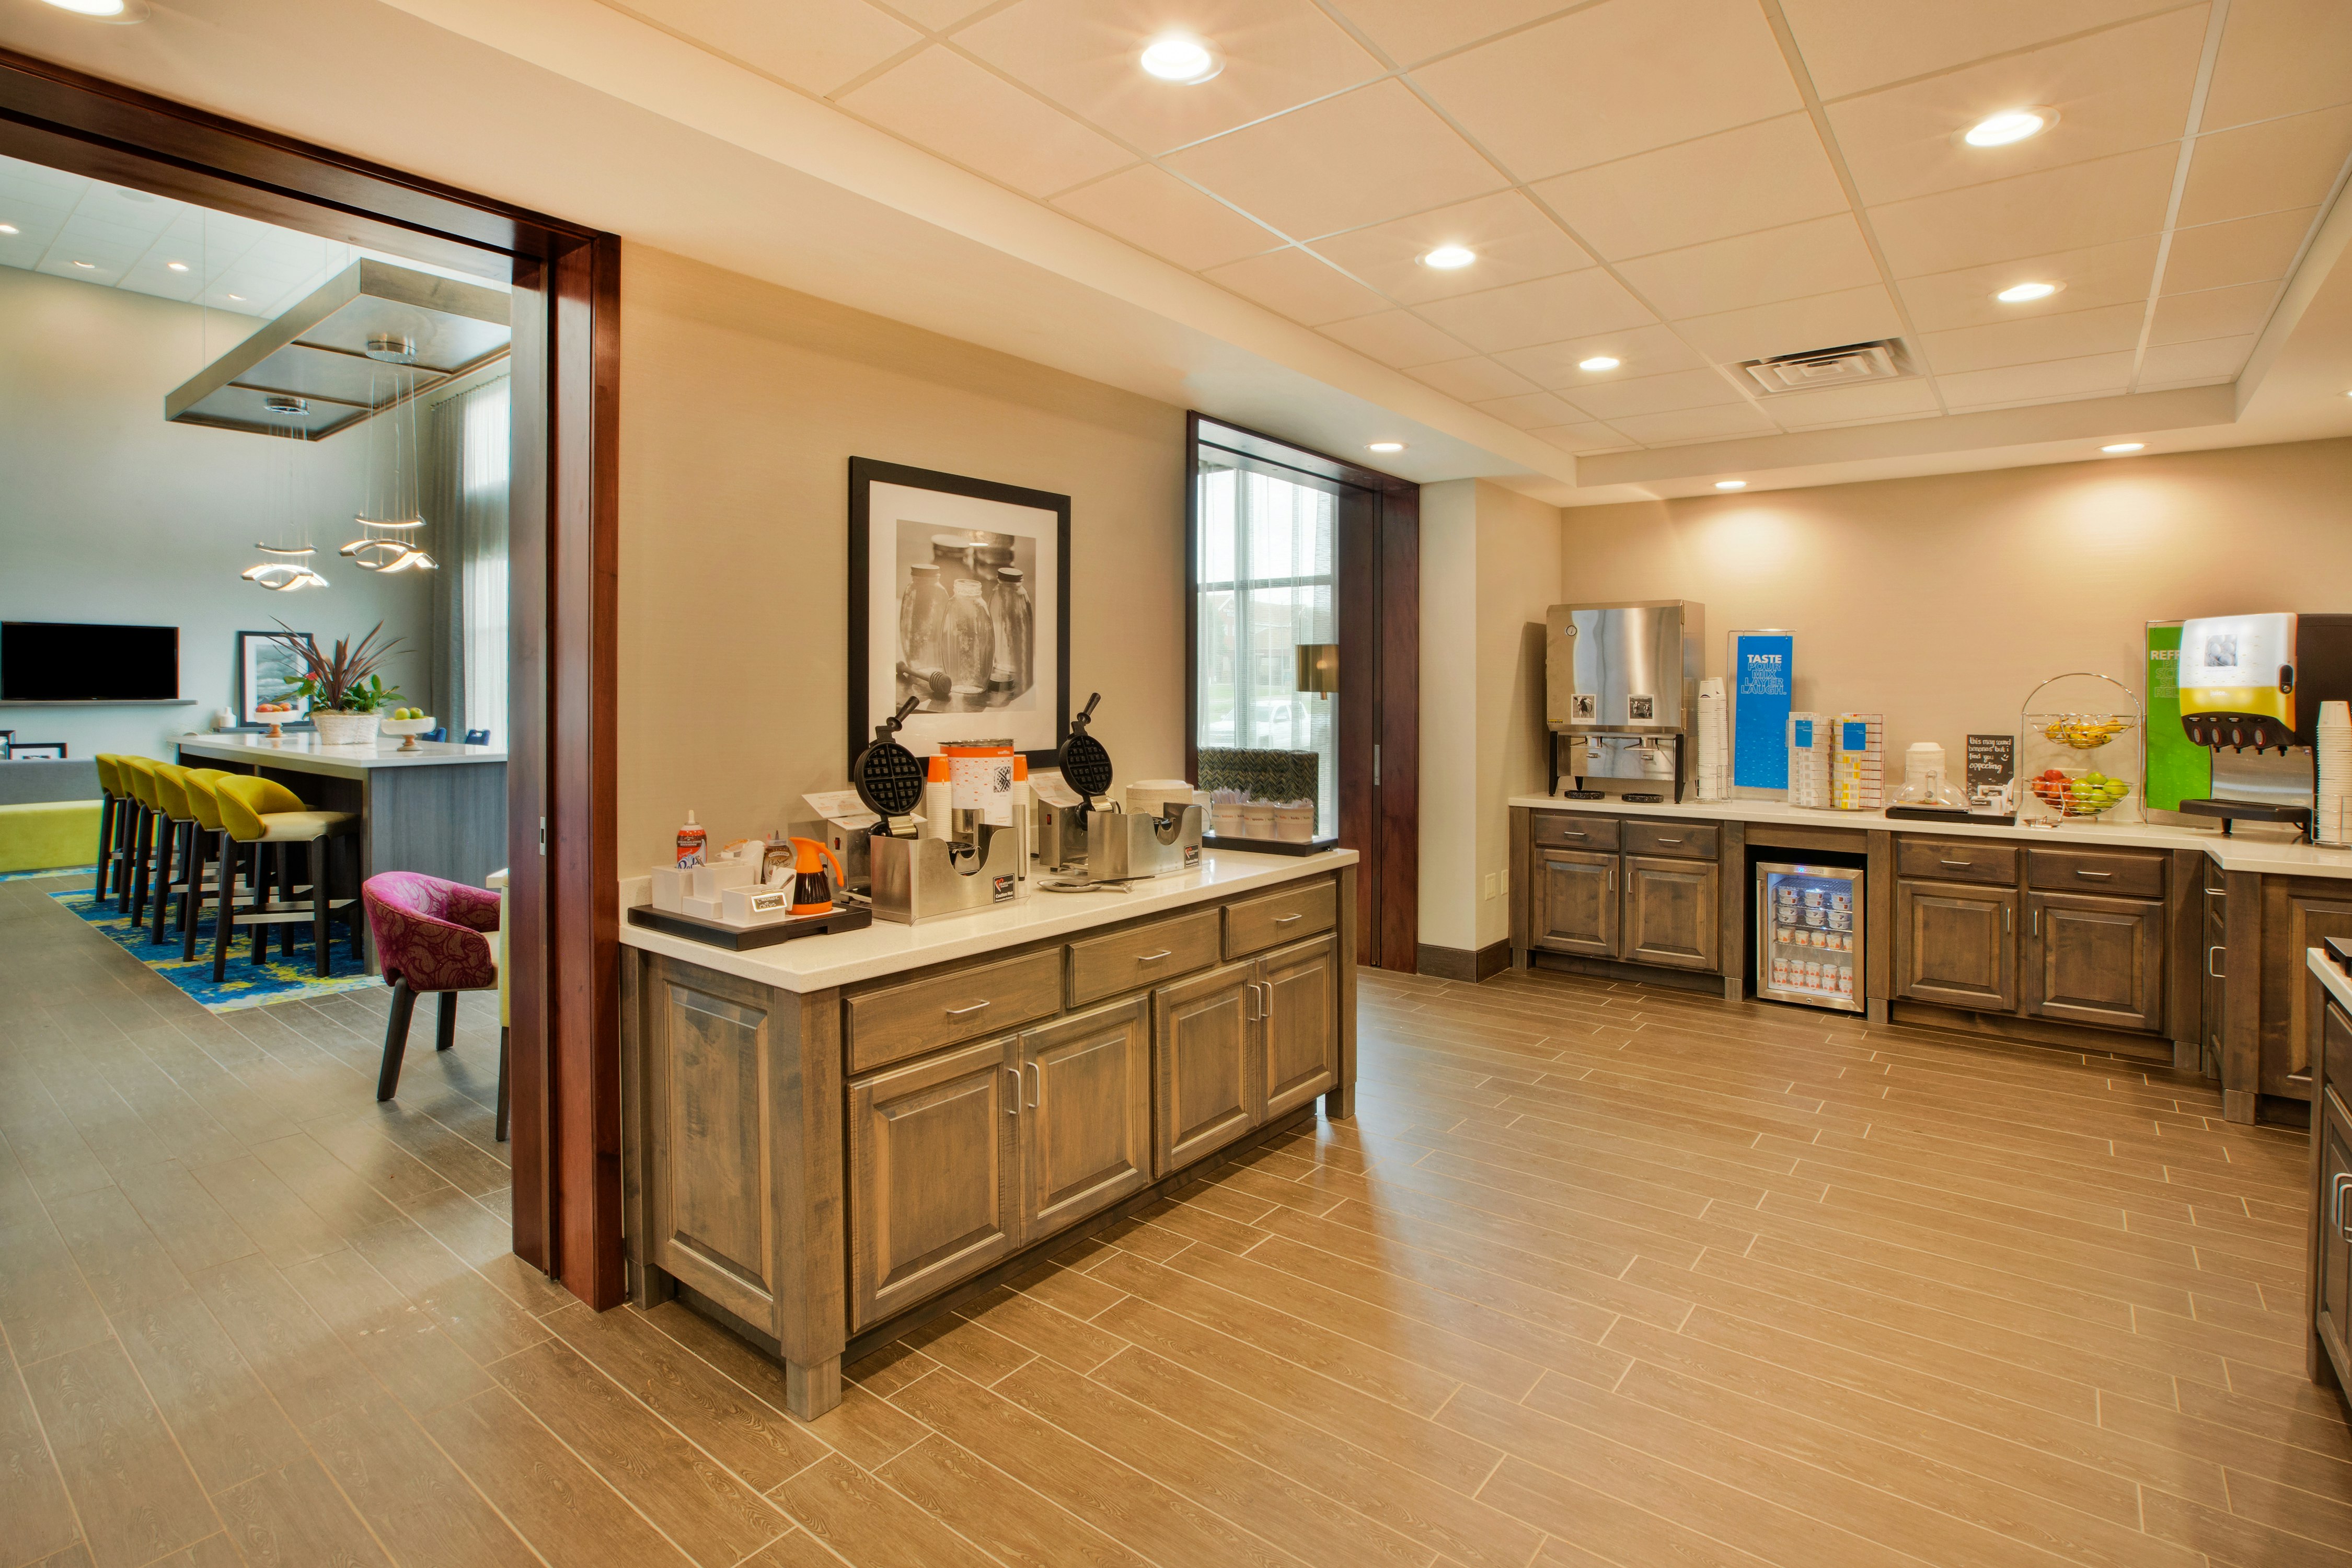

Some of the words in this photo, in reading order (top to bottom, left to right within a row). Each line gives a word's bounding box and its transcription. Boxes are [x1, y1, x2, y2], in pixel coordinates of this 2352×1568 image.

[1747, 654, 1782, 663] TASTE
[1748, 662, 1781, 671] POUR
[1752, 670, 1777, 678] MIX
[1745, 677, 1783, 687] LAYER
[1741, 685, 1787, 695] LAUGH.
[1982, 740, 1996, 748] may
[1983, 755, 1994, 763] you
